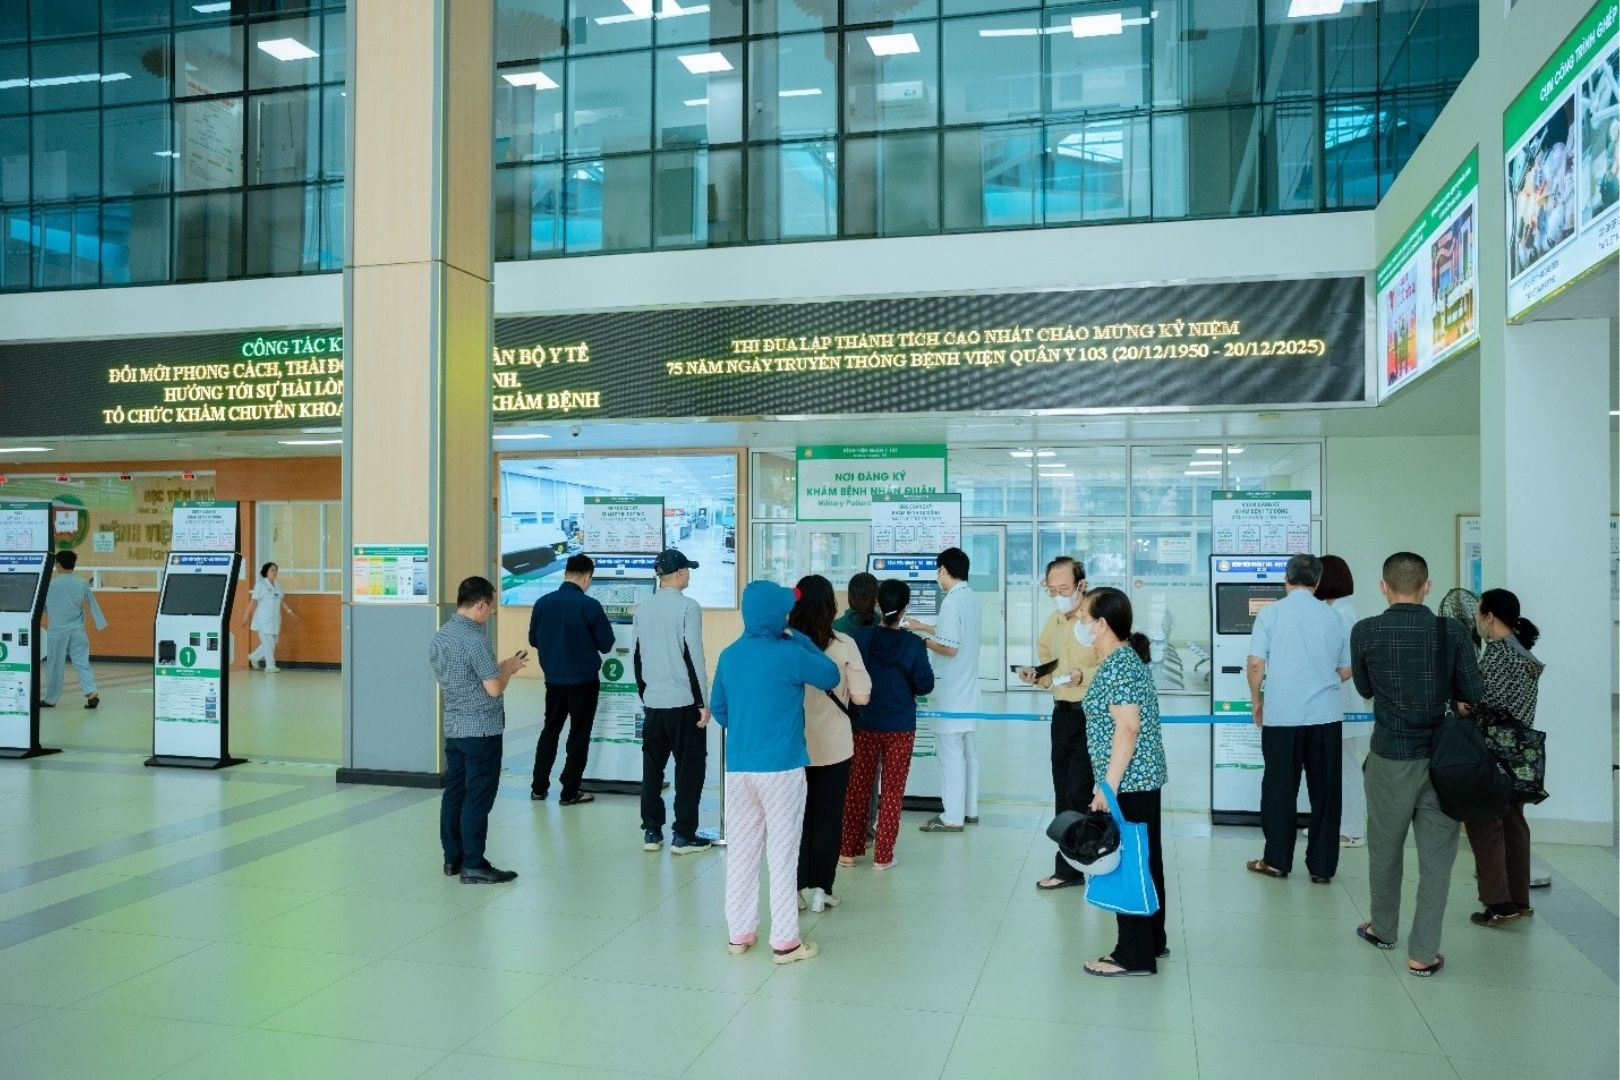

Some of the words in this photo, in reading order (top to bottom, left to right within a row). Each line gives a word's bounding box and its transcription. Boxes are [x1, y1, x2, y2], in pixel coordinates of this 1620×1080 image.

[1554, 54, 1575, 86] CÔNG
[1575, 31, 1596, 63] TRÌNH
[242, 337, 290, 357] CÔNG
[291, 335, 326, 355] TÁC
[731, 339, 761, 354] THI
[762, 338, 798, 353] ĐUA
[799, 335, 832, 354] LẬP
[943, 330, 981, 345] CAO
[1187, 320, 1240, 340] NIỆM
[139, 363, 171, 382] MỚI
[173, 364, 230, 382] PHONG
[328, 358, 343, 375] Đ
[518, 345, 546, 368] BỘ
[548, 347, 563, 364] Y
[564, 341, 590, 363] TẾ
[666, 361, 683, 375] 75
[685, 358, 724, 375] NĂM
[725, 356, 772, 374] NGÀY
[910, 351, 961, 369] BỆNH
[963, 348, 1006, 367] VIỆN
[1009, 344, 1061, 366] QUÂN
[1078, 347, 1108, 362] 103
[1112, 343, 1209, 364] (20/12/1950
[1223, 338, 1326, 357] 20/12/2025)
[164, 383, 224, 402] HƯỚNG
[225, 382, 254, 400] TỚI
[256, 380, 281, 401] SỰ
[103, 405, 125, 424] TỔ
[127, 405, 174, 424] CHỨC
[175, 403, 227, 423] KHÁM
[228, 399, 297, 421] CHUYÊN
[546, 389, 601, 412] BỆNH
[857, 469, 890, 483] ĐĂNG
[806, 487, 837, 496] KHÁM
[840, 484, 867, 498] BỆNH
[185, 650, 191, 664] 1
[609, 662, 618, 677] 2
